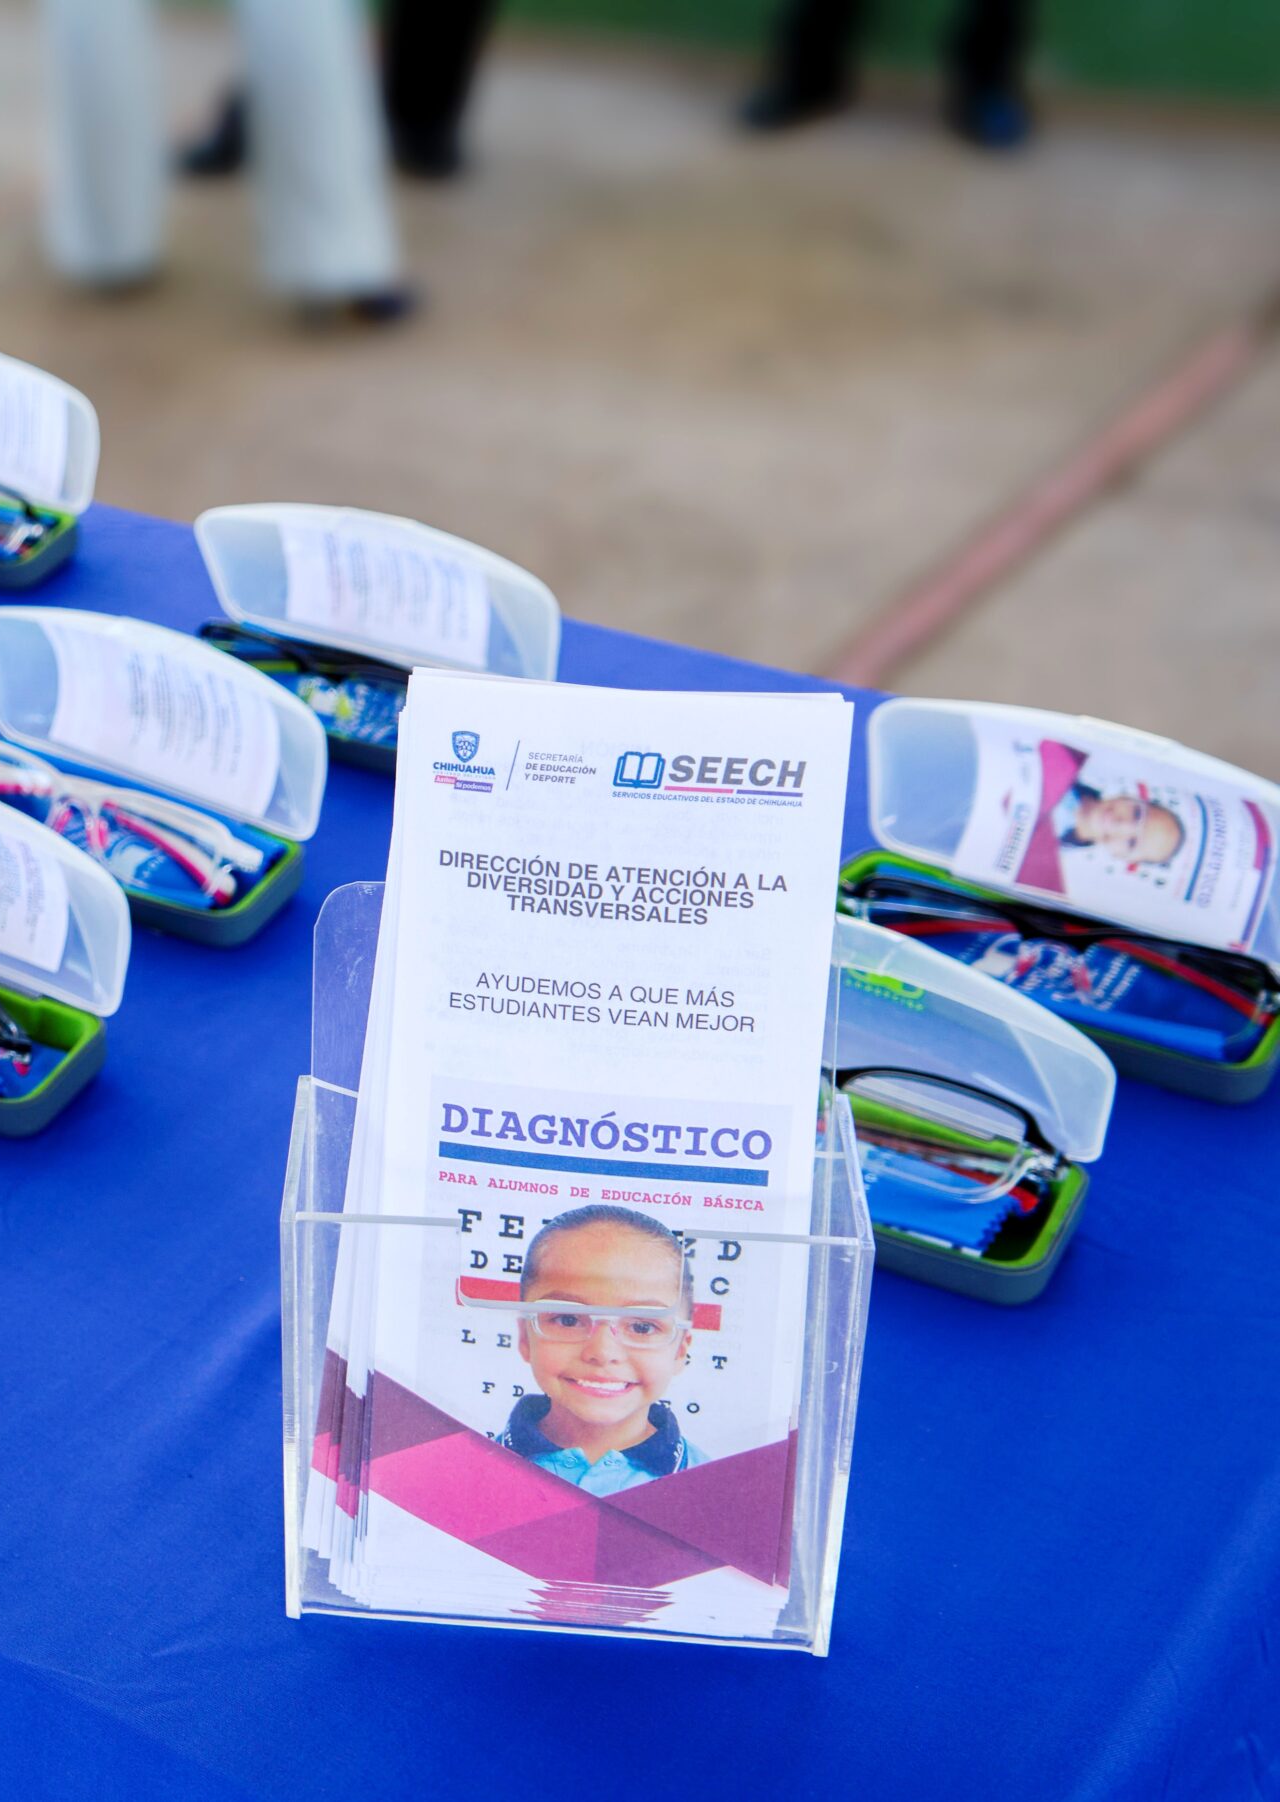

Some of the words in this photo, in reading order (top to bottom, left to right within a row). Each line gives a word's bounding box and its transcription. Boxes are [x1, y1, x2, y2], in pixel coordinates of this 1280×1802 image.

[433, 762, 496, 776] CHIHUAHUA
[525, 763, 538, 772] DE
[540, 763, 597, 775] EDUCACIÓN
[528, 752, 584, 763] SECRETARÍA
[669, 755, 807, 788] SEECH
[524, 773, 531, 781] Y
[532, 773, 577, 784] DEPORTE
[612, 791, 651, 800] SERVICIOS
[652, 793, 699, 802] EDUCATIVOS
[716, 796, 746, 805] ESTADO
[758, 798, 803, 808] CHIHUAHUA
[439, 849, 561, 878] DIRECCIÓN
[568, 863, 598, 881] DE
[605, 866, 726, 889] ATENCIÓN
[733, 873, 750, 890] A
[758, 874, 788, 892] LA
[467, 872, 603, 900] DIVERSIDAD
[610, 884, 625, 901] Y
[632, 886, 755, 908] ACCIONES
[507, 894, 708, 925] TRANSVERSALES
[476, 972, 601, 1000] AYUDEMOS
[608, 985, 624, 1001] A
[630, 986, 679, 1005] QUE
[686, 986, 735, 1008] MÁS
[449, 991, 601, 1023] ESTUDIANTES
[608, 1008, 669, 1028] VEAN
[676, 1012, 755, 1033] MEJOR
[441, 1102, 772, 1160] DIAGNÓSTICO
[439, 1171, 478, 1186] PARA
[488, 1178, 559, 1196] ALUMNOS
[570, 1186, 590, 1200] DE
[601, 1188, 692, 1207] EDUCACIÓN
[703, 1194, 765, 1212] BÁSICA
[458, 1208, 482, 1233] F
[498, 1214, 524, 1239] E
[717, 1240, 742, 1261] D
[470, 1250, 489, 1269] D
[502, 1254, 523, 1274] E
[710, 1277, 730, 1295] C
[461, 1329, 476, 1344] L
[496, 1333, 511, 1348] E
[712, 1355, 728, 1369] T
[482, 1381, 495, 1394] F
[512, 1385, 524, 1397] D
